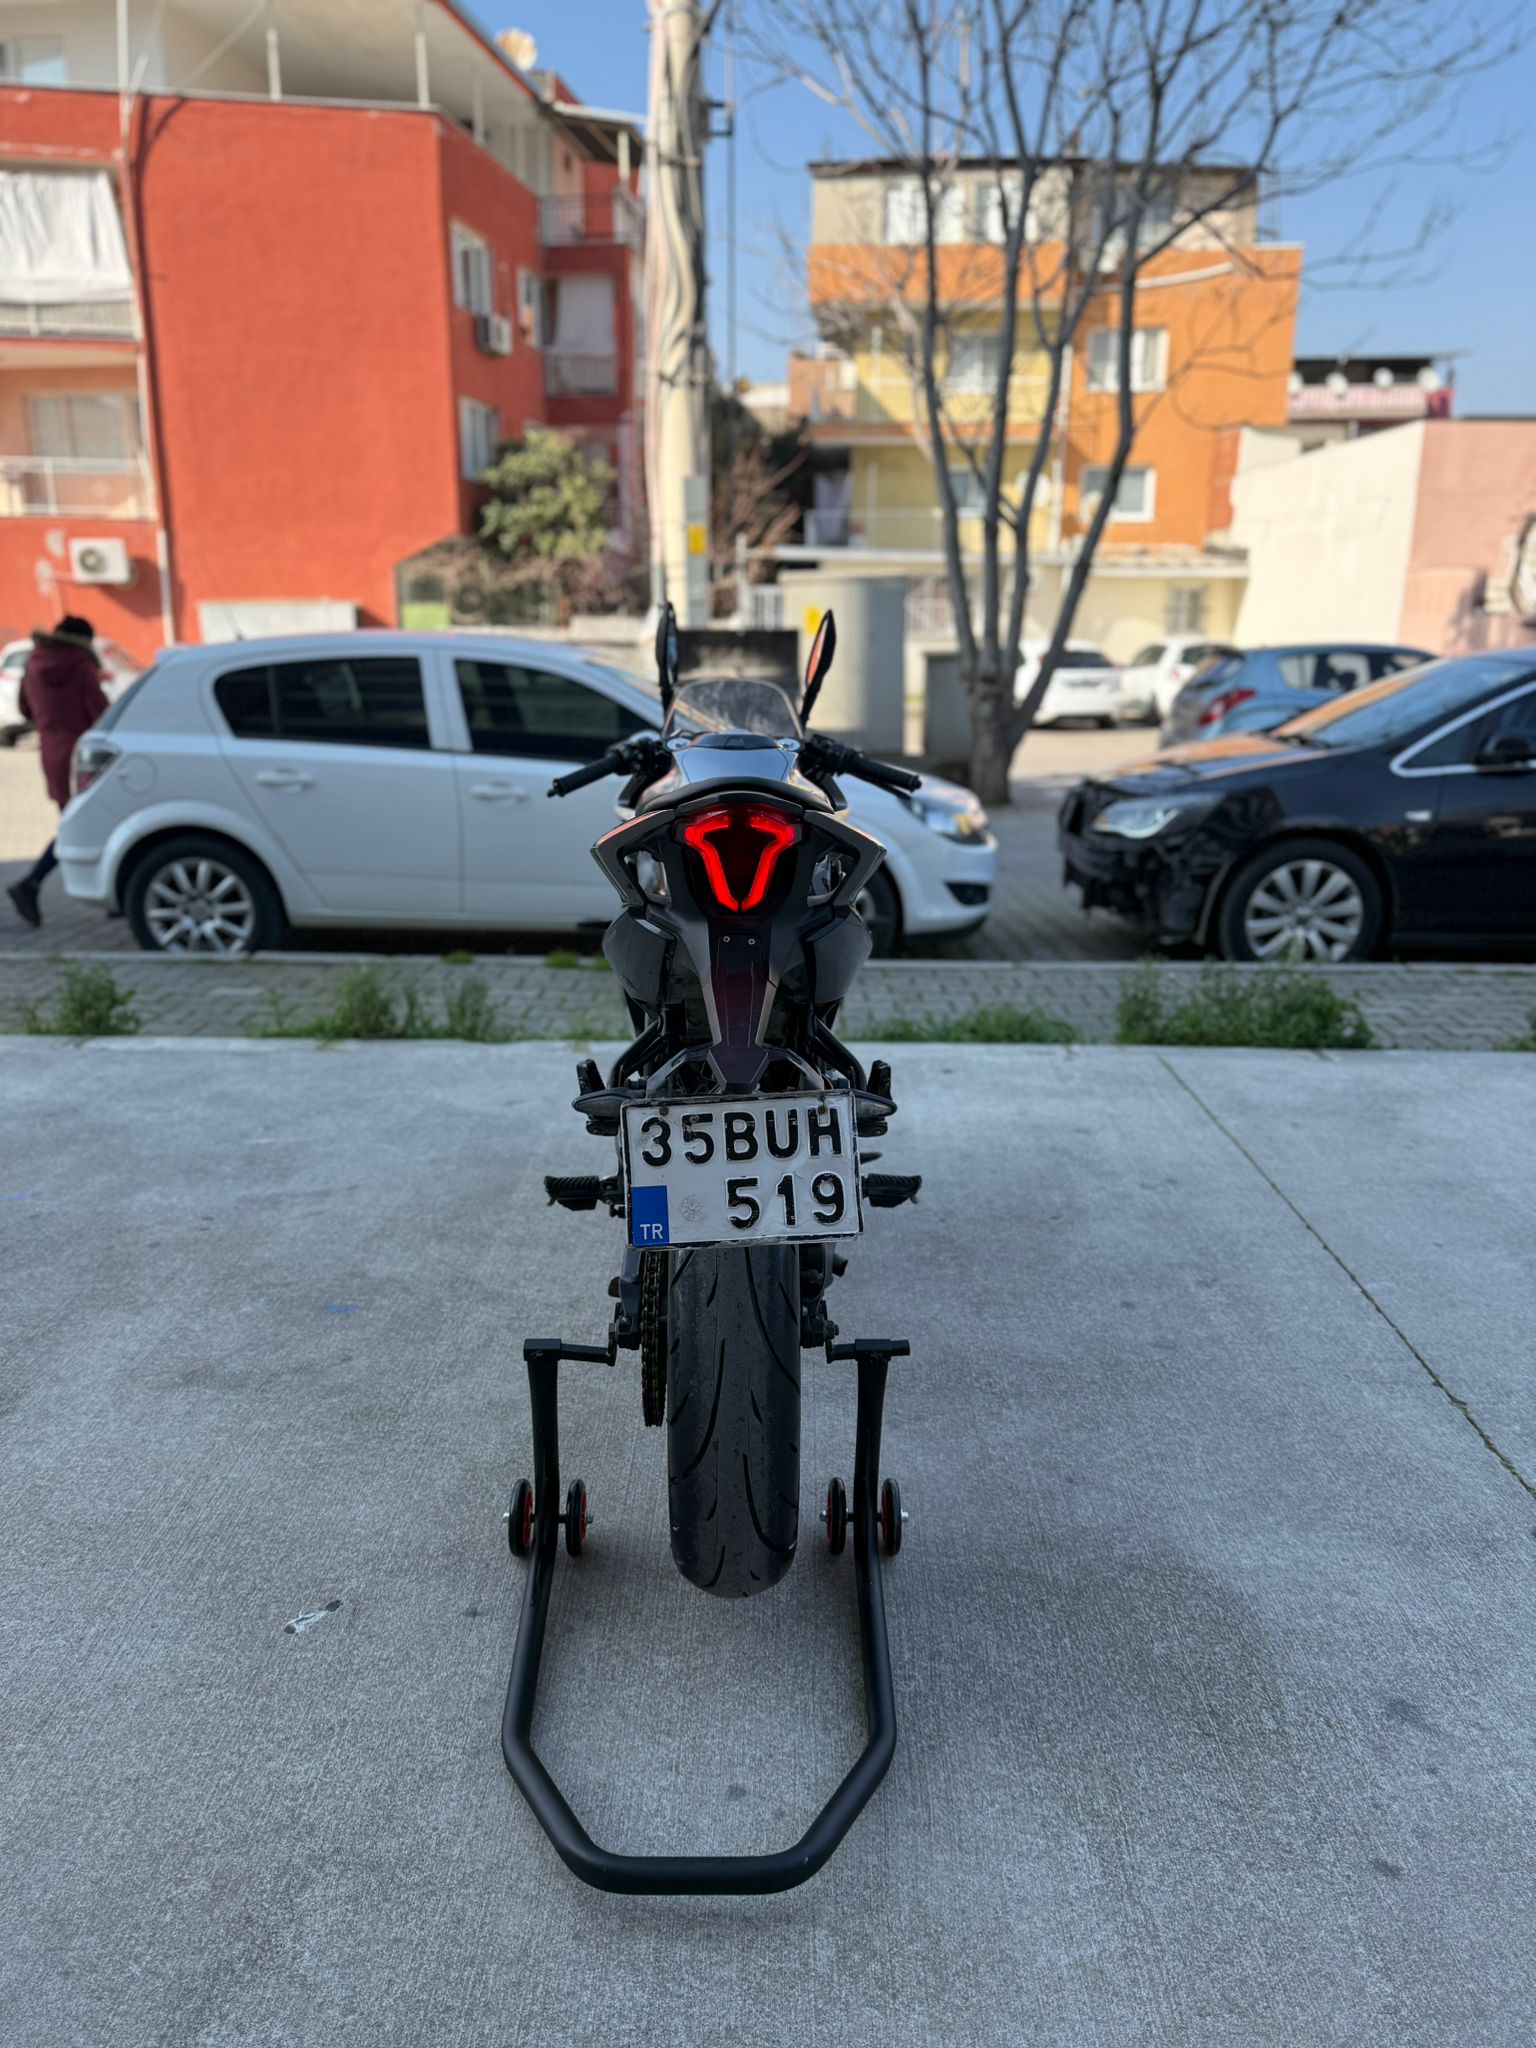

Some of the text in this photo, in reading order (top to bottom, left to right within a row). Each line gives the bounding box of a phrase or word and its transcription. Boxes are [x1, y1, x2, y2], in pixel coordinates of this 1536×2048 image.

[640, 1108, 843, 1167] 35BUH
[726, 1172, 845, 1230] 519
[639, 1223, 664, 1241] TR
